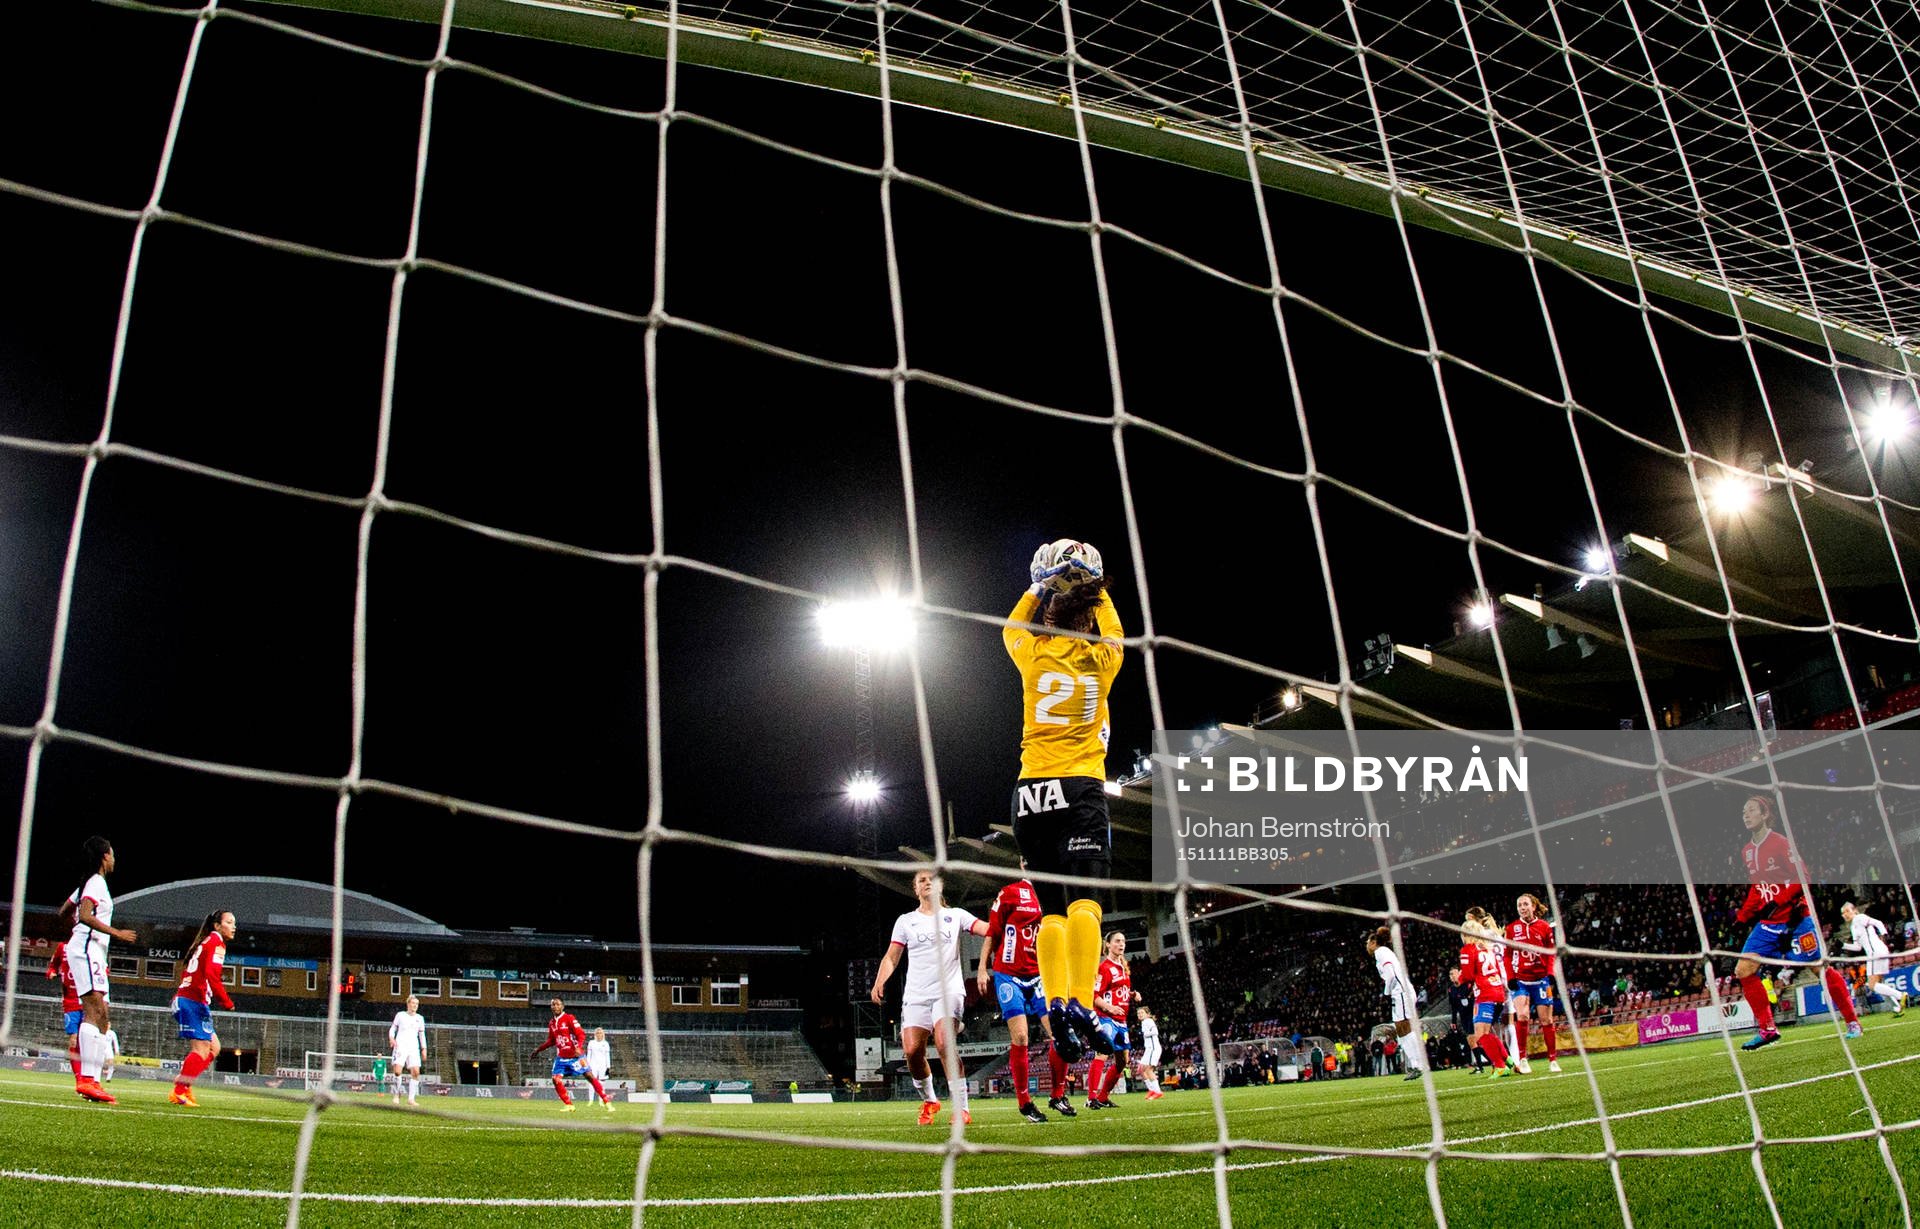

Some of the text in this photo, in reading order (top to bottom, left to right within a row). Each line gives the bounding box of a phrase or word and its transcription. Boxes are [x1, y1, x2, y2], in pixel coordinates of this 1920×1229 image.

[1035, 671, 1100, 726] 21
[1016, 778, 1070, 818] NA
[1791, 939, 1801, 955] 5
[149, 949, 181, 959] EXACT
[366, 963, 375, 972] Vi
[1669, 1023, 1691, 1034] VARA
[224, 1075, 242, 1085] NA
[475, 1087, 493, 1098] NA
